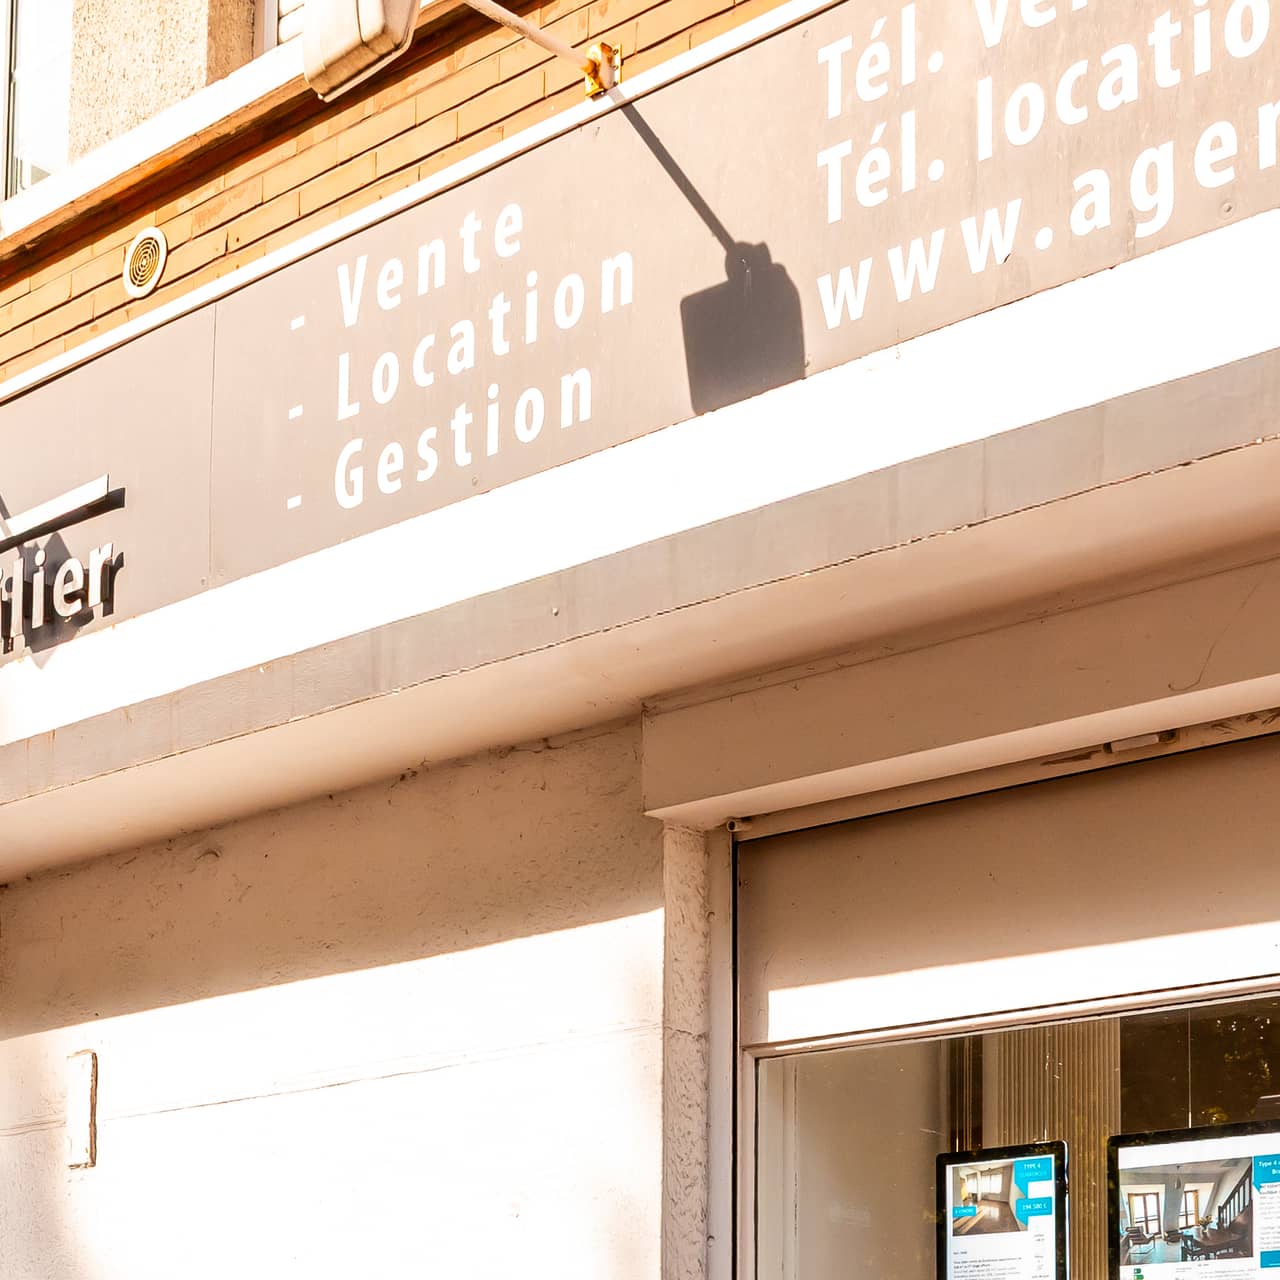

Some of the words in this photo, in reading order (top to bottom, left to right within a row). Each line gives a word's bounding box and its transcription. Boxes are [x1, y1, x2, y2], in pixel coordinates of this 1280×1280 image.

[817, 3, 944, 120] Tél.
[817, 110, 945, 224] Tél.
[337, 203, 523, 327] Vente
[337, 251, 634, 421] Location
[334, 366, 592, 509] Gestion
